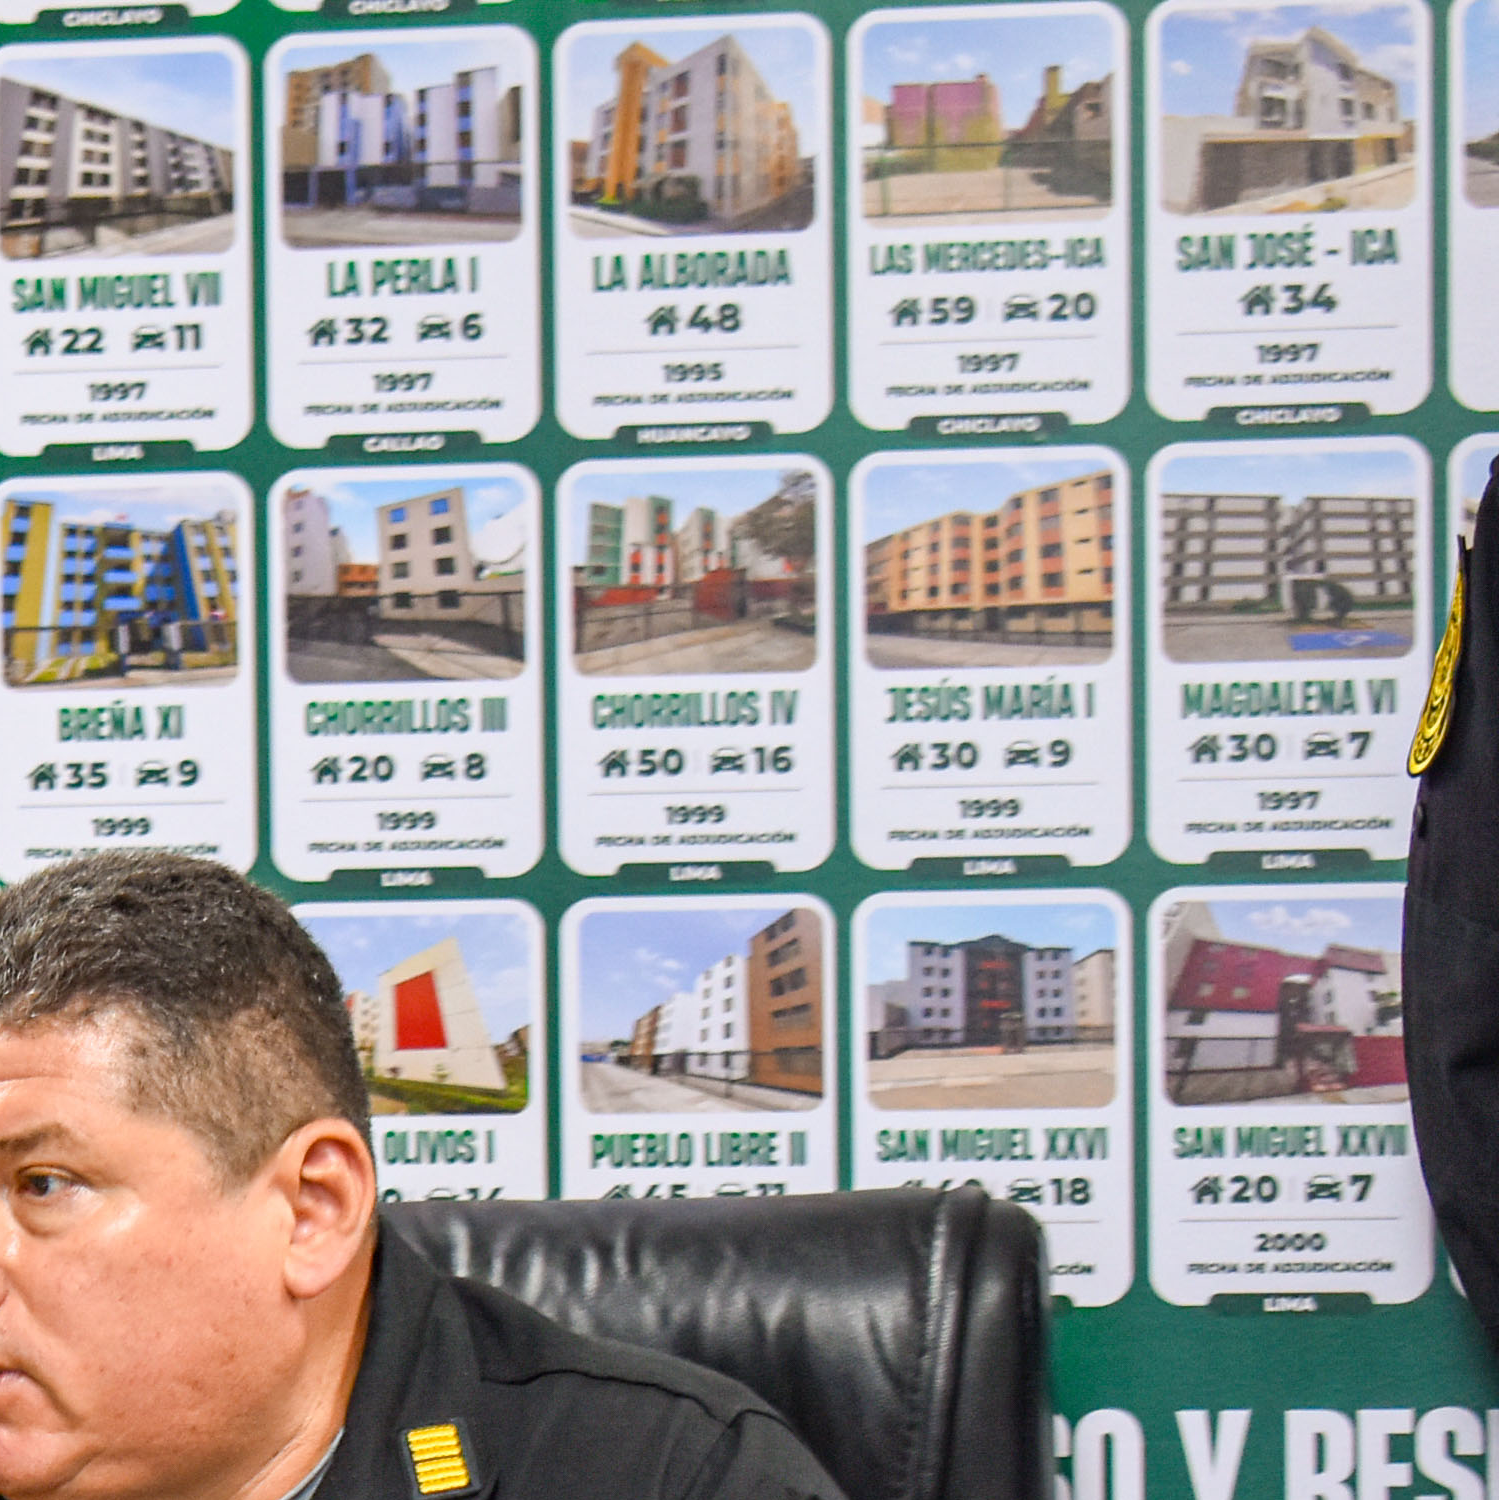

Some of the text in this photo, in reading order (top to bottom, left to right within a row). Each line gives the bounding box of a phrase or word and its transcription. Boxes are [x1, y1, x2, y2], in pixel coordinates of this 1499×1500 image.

[870, 237, 1106, 276] LAS MERCEDES-ICA
[1177, 235, 1235, 272] SAN
[1245, 224, 1315, 270] JOSÉ
[1351, 229, 1399, 266] ICA
[328, 256, 479, 298] LA PERLA I
[594, 249, 792, 292] LA ALBORADA
[14, 272, 222, 313] SAN MIGUEL VII
[929, 293, 1097, 325] 59 20
[1282, 283, 1338, 315] 34
[346, 313, 483, 345] 32 6
[306, 697, 508, 736] CHORRILLOS III
[592, 690, 799, 730] CHORRILLOS IV
[886, 676, 1096, 723] JESÚS MARÍA I
[1182, 678, 1397, 719] MAGDALENA VI
[1228, 731, 1373, 762] 30 7
[66, 760, 200, 789] 35 9
[1257, 791, 1321, 811] 1997
[384, 1130, 495, 1165] OLIVOS I
[592, 1131, 808, 1168] PUEBLO LIBRE II
[877, 1127, 1108, 1162] SAN MIGUEL XXVI
[1230, 1174, 1373, 1203] 20 7
[1256, 1233, 1327, 1252] 2000
